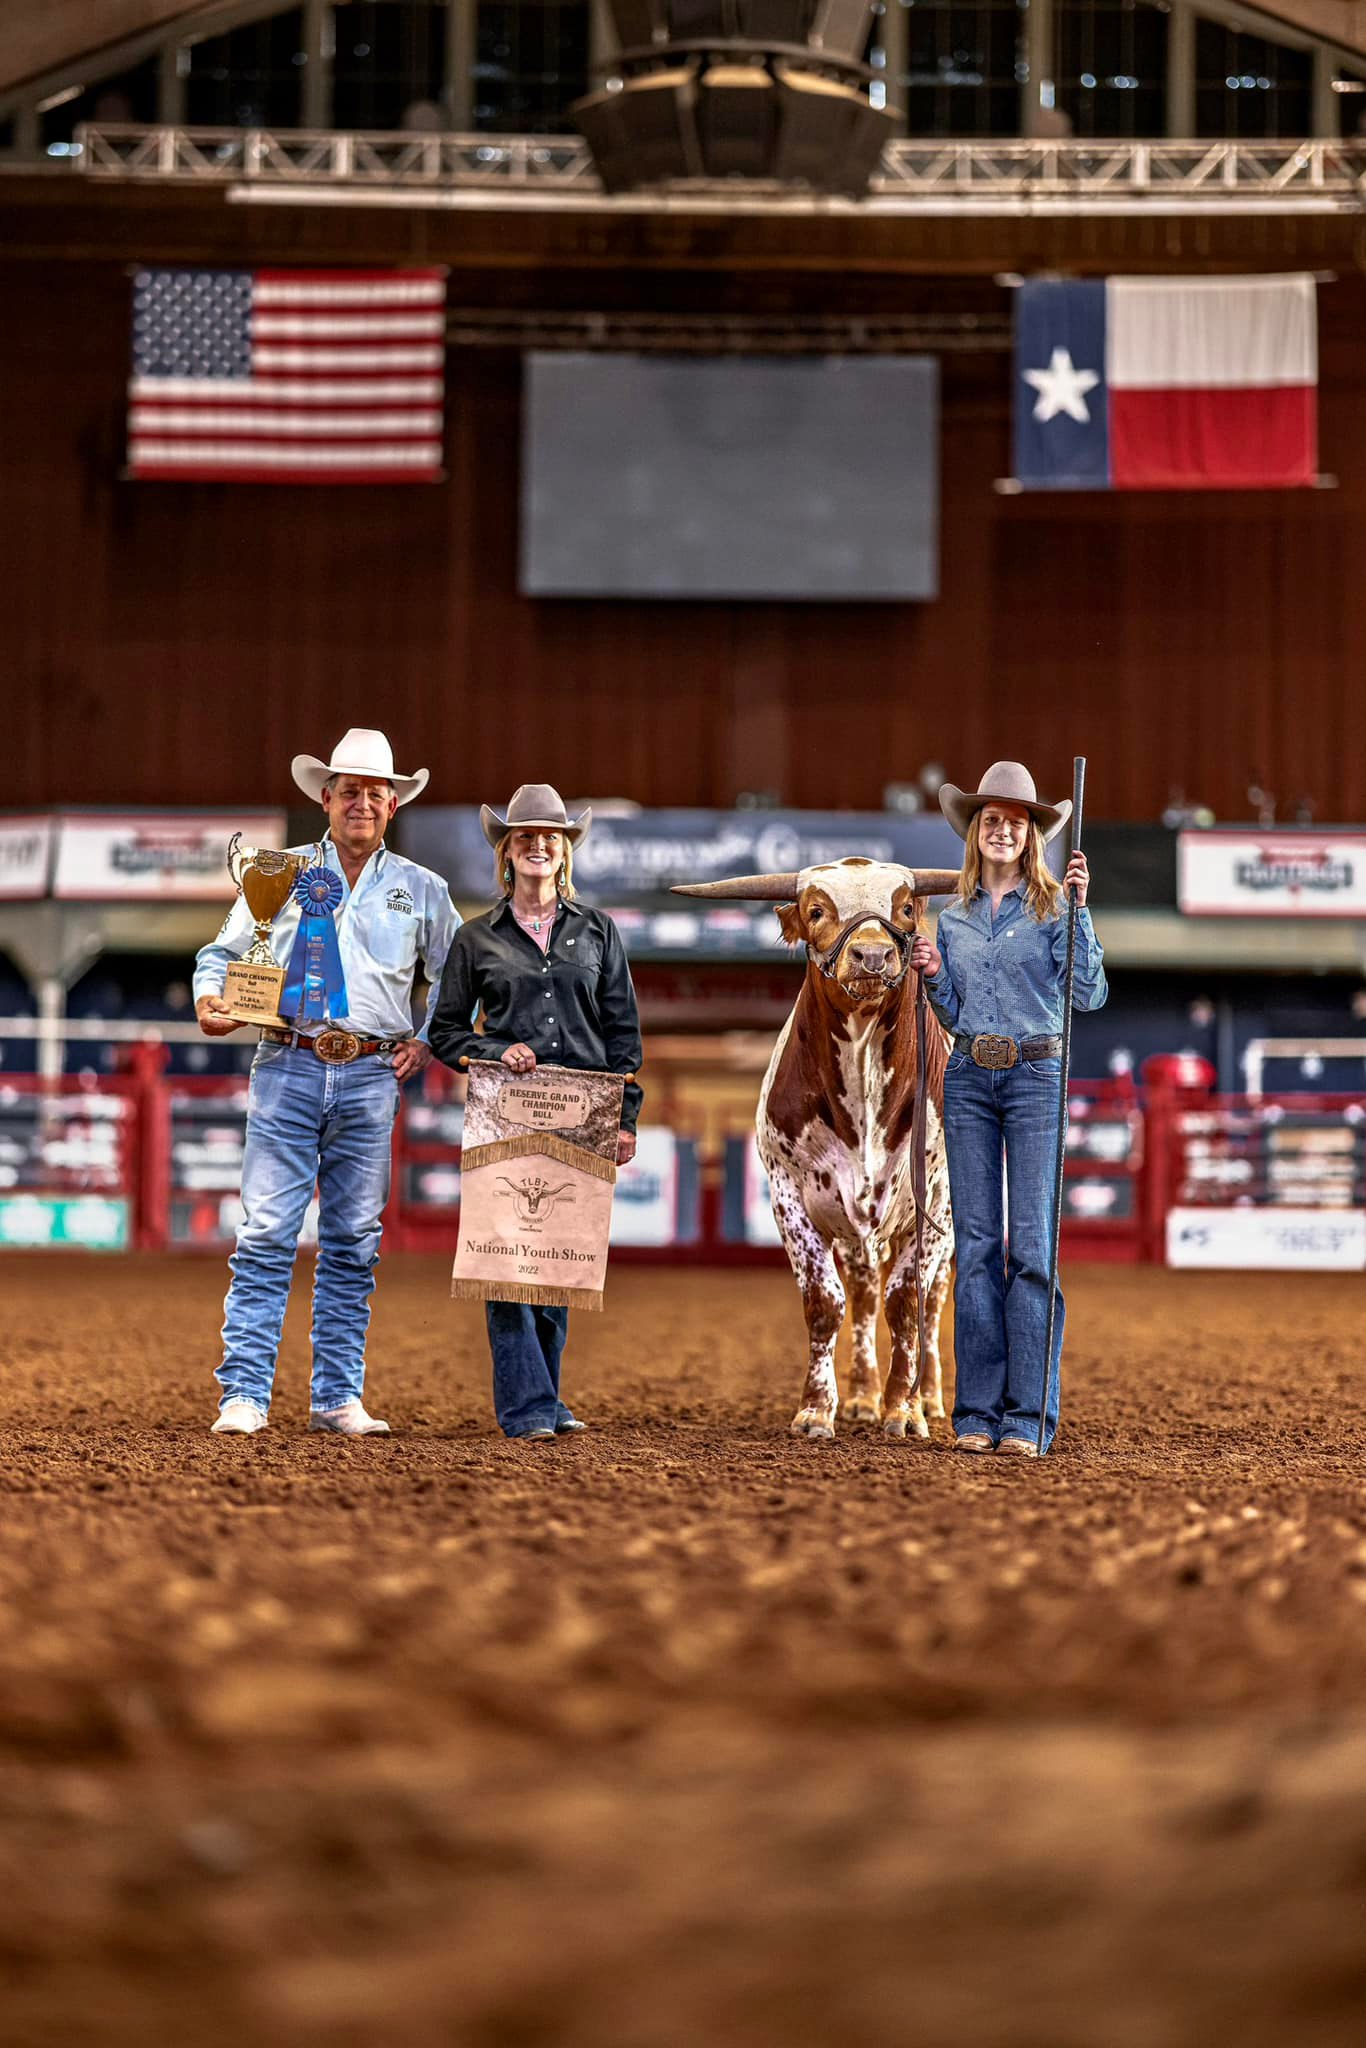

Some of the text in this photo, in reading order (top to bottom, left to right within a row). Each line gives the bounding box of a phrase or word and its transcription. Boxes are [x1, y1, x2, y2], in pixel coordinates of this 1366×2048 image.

[249, 974, 278, 983] CHAMPION
[509, 1089, 580, 1103] RESERVE GRAND
[522, 1099, 566, 1111] CHAMPION
[533, 1110, 553, 1119] BULL
[520, 1177, 549, 1189] TLBT
[465, 1240, 597, 1263] National Youth Show
[518, 1264, 539, 1275] 2022
